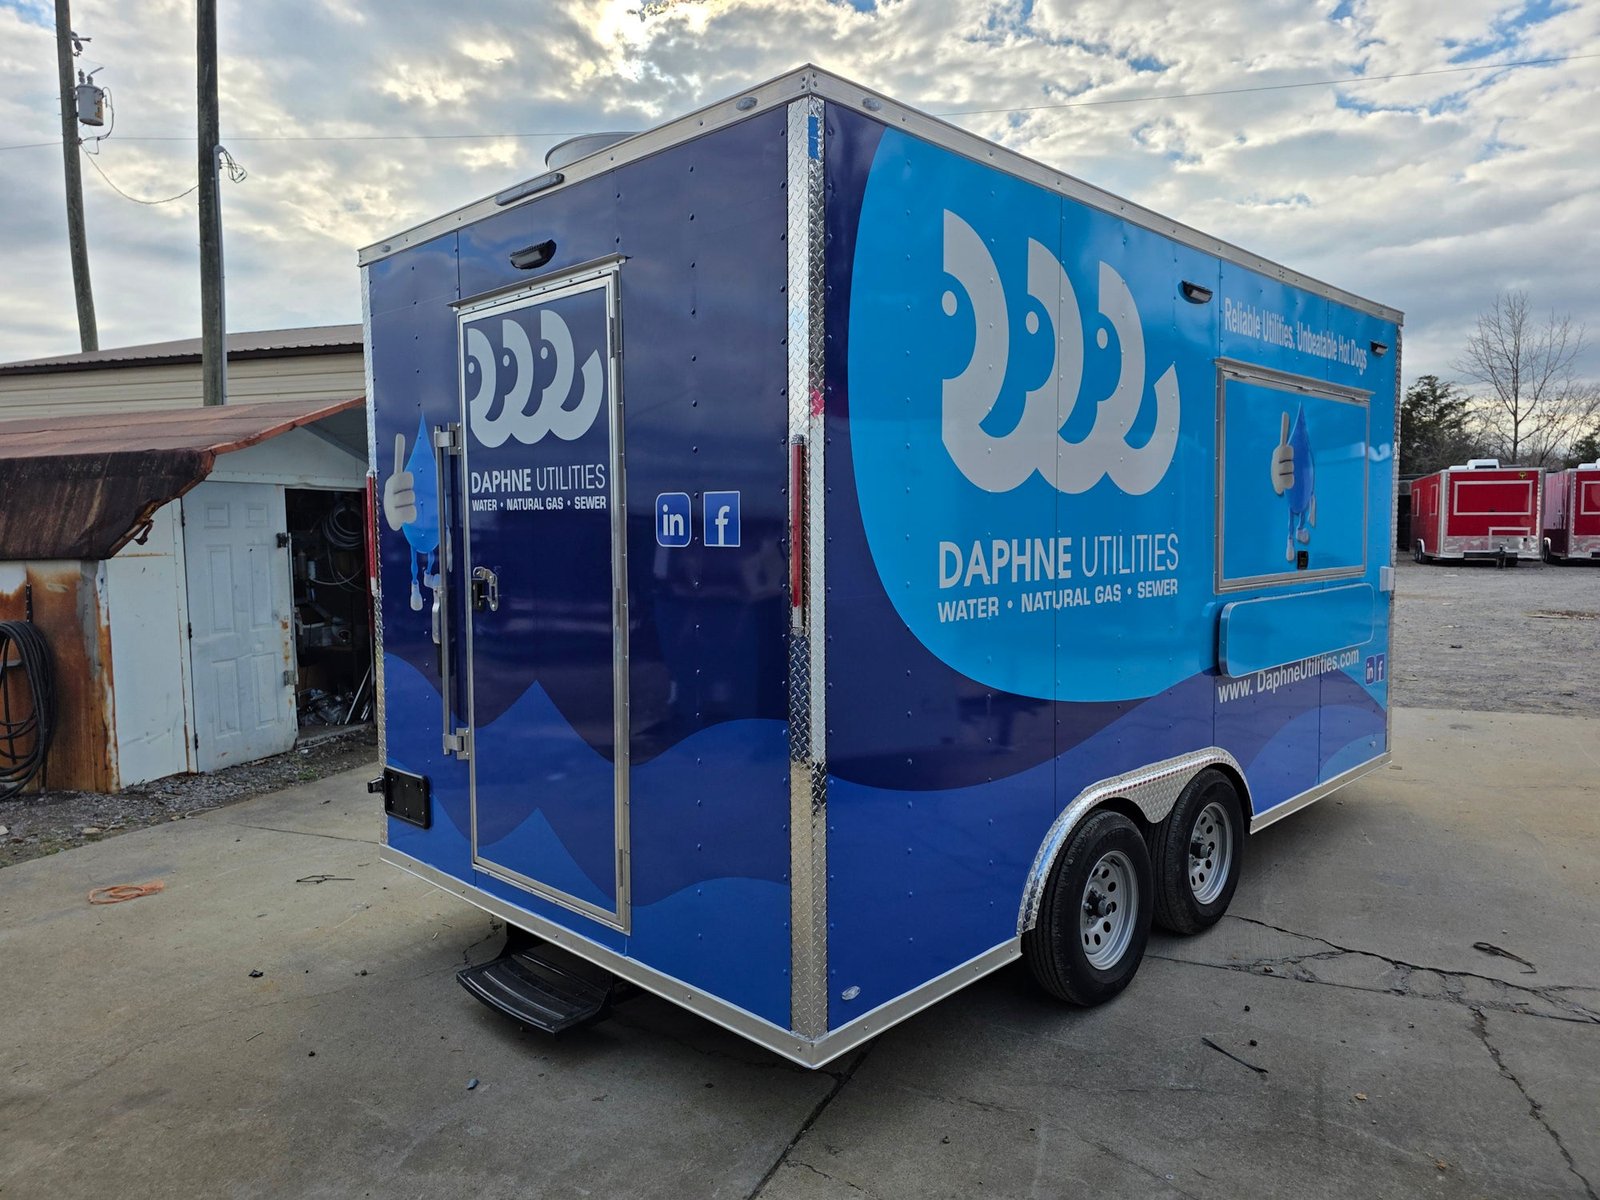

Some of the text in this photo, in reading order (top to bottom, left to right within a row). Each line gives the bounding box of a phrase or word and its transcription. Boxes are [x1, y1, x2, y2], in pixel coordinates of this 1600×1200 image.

[1224, 297, 1368, 376] Reliable Utilities. Unbeatable Hot Dogs
[471, 463, 606, 494] DAPHNE UTILITIES
[471, 495, 607, 512] WATER NATURAL GAS SEWER
[939, 533, 1179, 589] DAPHNE UTILITIES
[937, 578, 1178, 623] WATER NATURAL GAS SEWER
